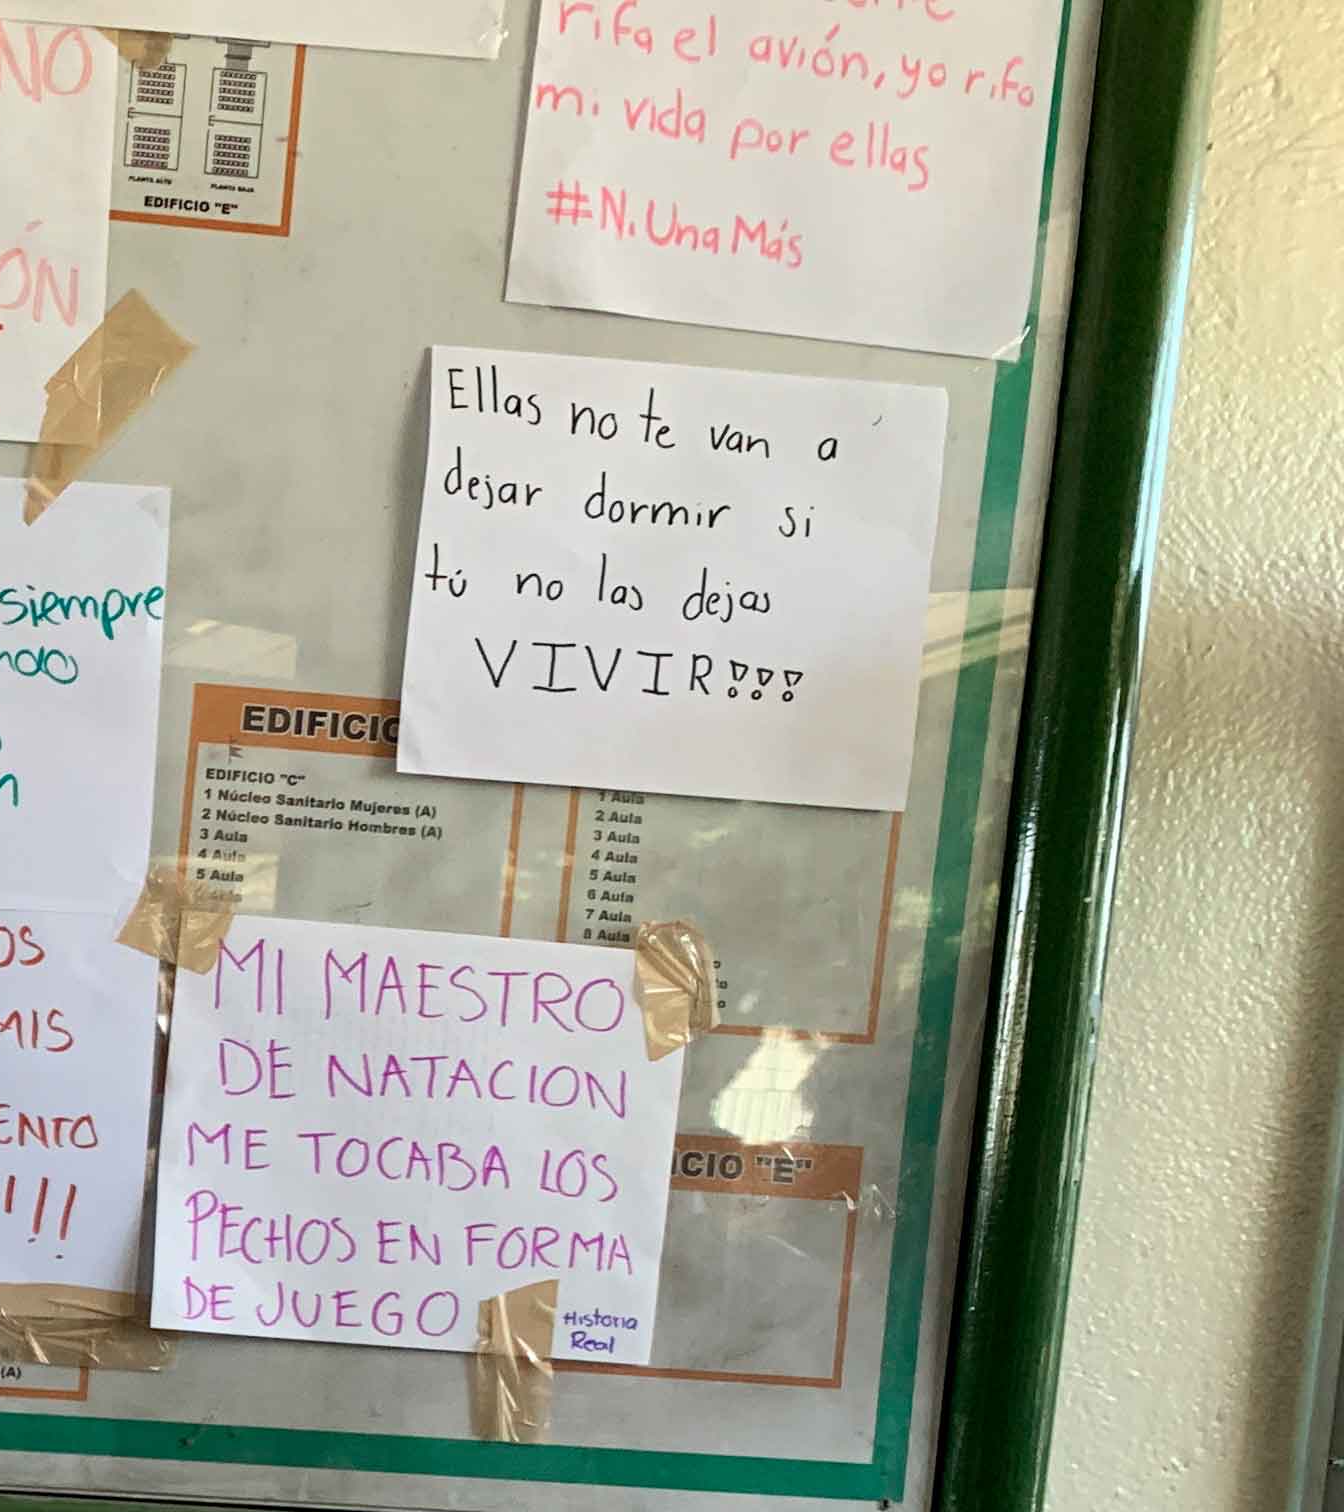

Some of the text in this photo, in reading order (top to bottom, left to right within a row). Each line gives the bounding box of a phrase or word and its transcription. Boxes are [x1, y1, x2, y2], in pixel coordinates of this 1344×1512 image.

[144, 196, 238, 215] EDIFICIO "E"
[446, 368, 840, 463] Ellas no te van a
[444, 447, 815, 541] dejar dormir si
[423, 541, 773, 623] tú no las dejas
[205, 768, 306, 786] EDIFICIO "C"
[204, 788, 437, 819] 1 Núcleo Sanitario Mujeres (A)
[201, 808, 443, 839] 2 Núcleo Sanitario Hombres (A)
[595, 810, 643, 824] 2 Aula
[593, 830, 640, 844] 3 Aula
[591, 850, 638, 864] 4 Aula
[589, 869, 636, 884] 5 Aula
[215, 937, 285, 1015] MI
[323, 950, 626, 1034] MAESTRO
[218, 1040, 628, 1119] DE NATACION
[563, 1309, 638, 1330] Historia
[571, 1330, 615, 1353] Real
[0, 1366, 21, 1380] (A)
